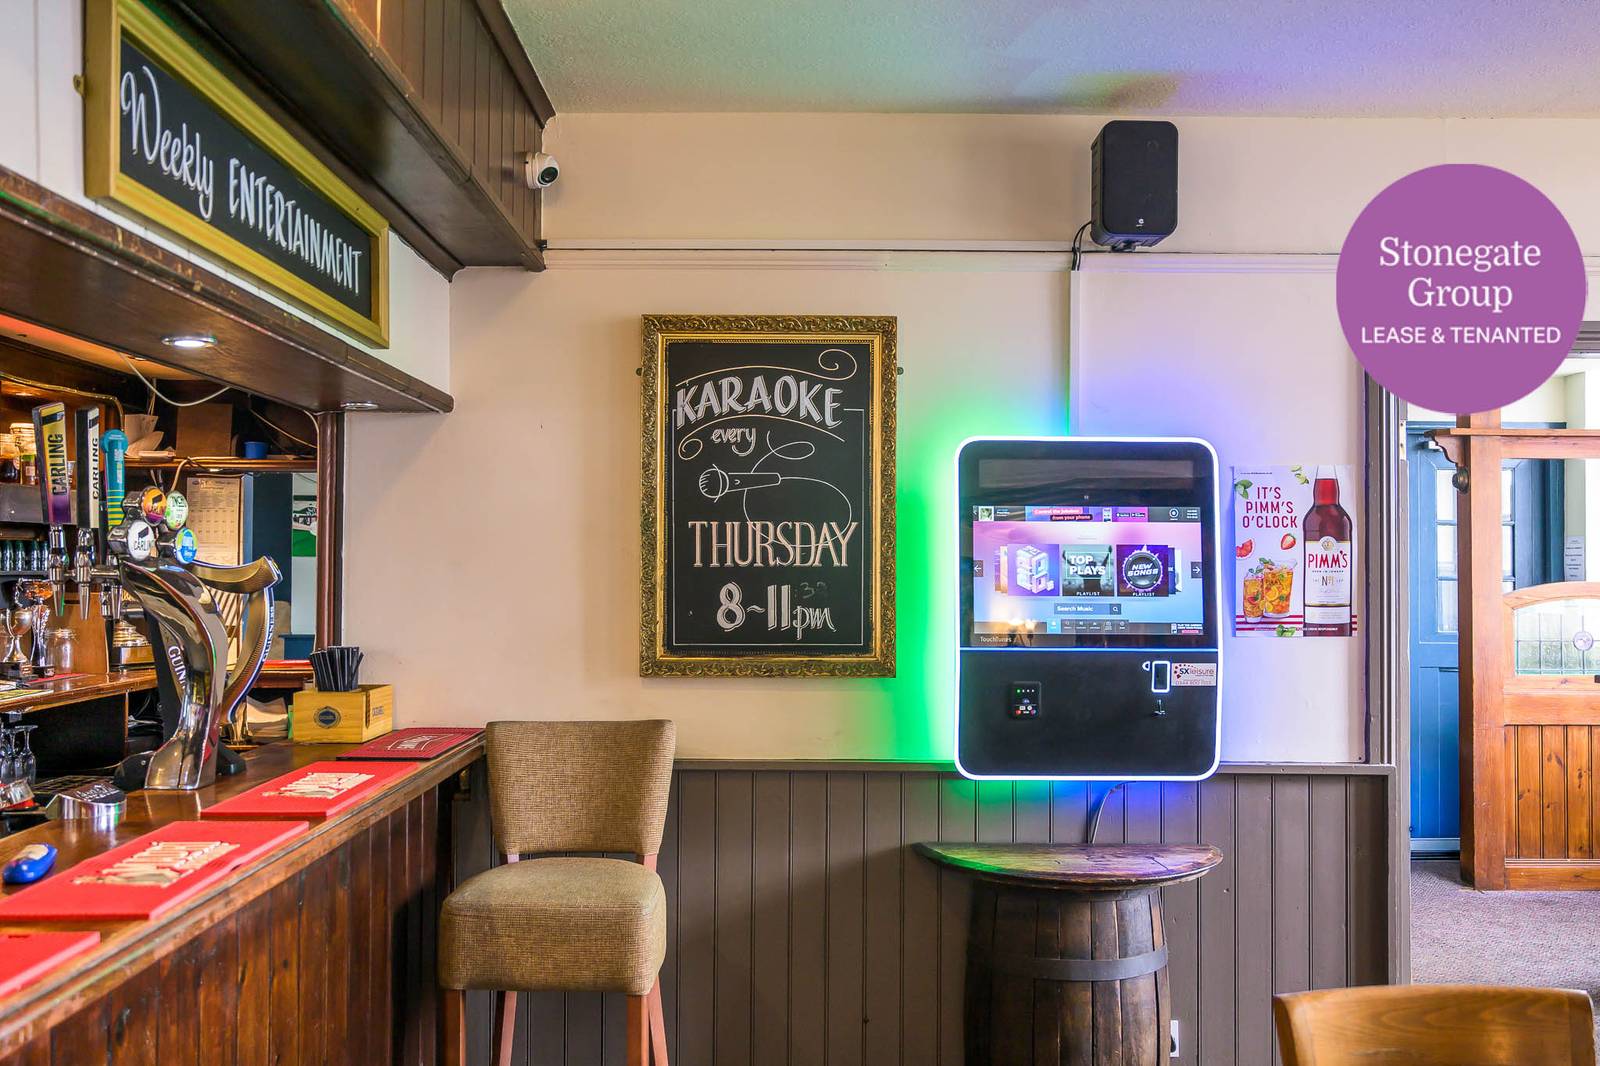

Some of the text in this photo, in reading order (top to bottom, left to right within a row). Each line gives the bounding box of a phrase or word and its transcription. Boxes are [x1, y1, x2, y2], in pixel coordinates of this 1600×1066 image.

[120, 65, 362, 295] Weekly ENTERTAINMENT
[676, 374, 844, 430] KARAOKE
[710, 427, 757, 457] every
[47, 433, 67, 496] CARLING
[1257, 487, 1281, 499] IT'S
[1245, 501, 1294, 514] PIMM'S
[1242, 515, 1298, 529] O'CLOCK
[688, 521, 859, 568] THURSDAY
[1070, 555, 1093, 564] TOP
[1308, 550, 1348, 569] PIMM'S
[1069, 566, 1106, 575] PLAYS
[1127, 569, 1158, 577] SONGS
[1131, 563, 1152, 571] NEW
[1057, 605, 1094, 613] Search Music
